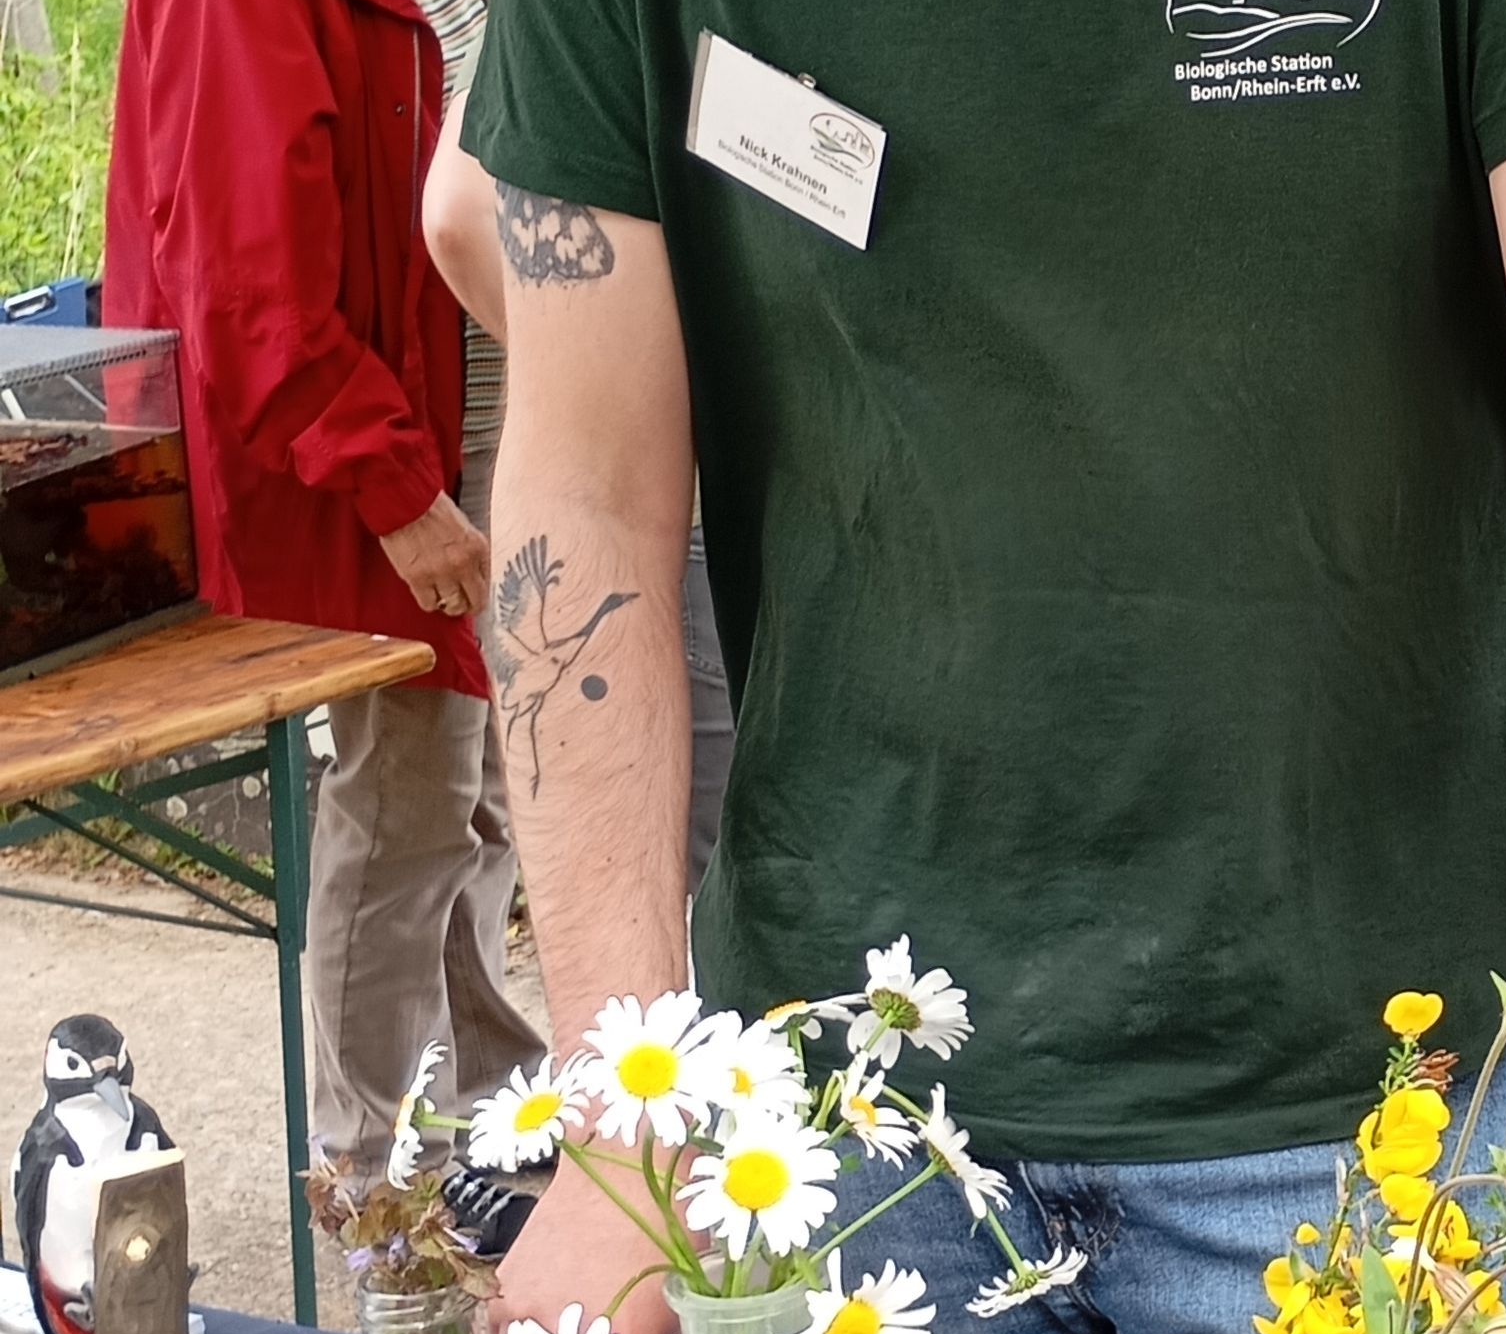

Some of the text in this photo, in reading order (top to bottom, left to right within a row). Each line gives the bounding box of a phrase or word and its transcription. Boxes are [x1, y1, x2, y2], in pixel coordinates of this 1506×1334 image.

[1175, 53, 1333, 80] Biologische Station
[1190, 73, 1361, 101] Bonn/Rhein-Erft e.V.
[740, 135, 768, 161] Nick
